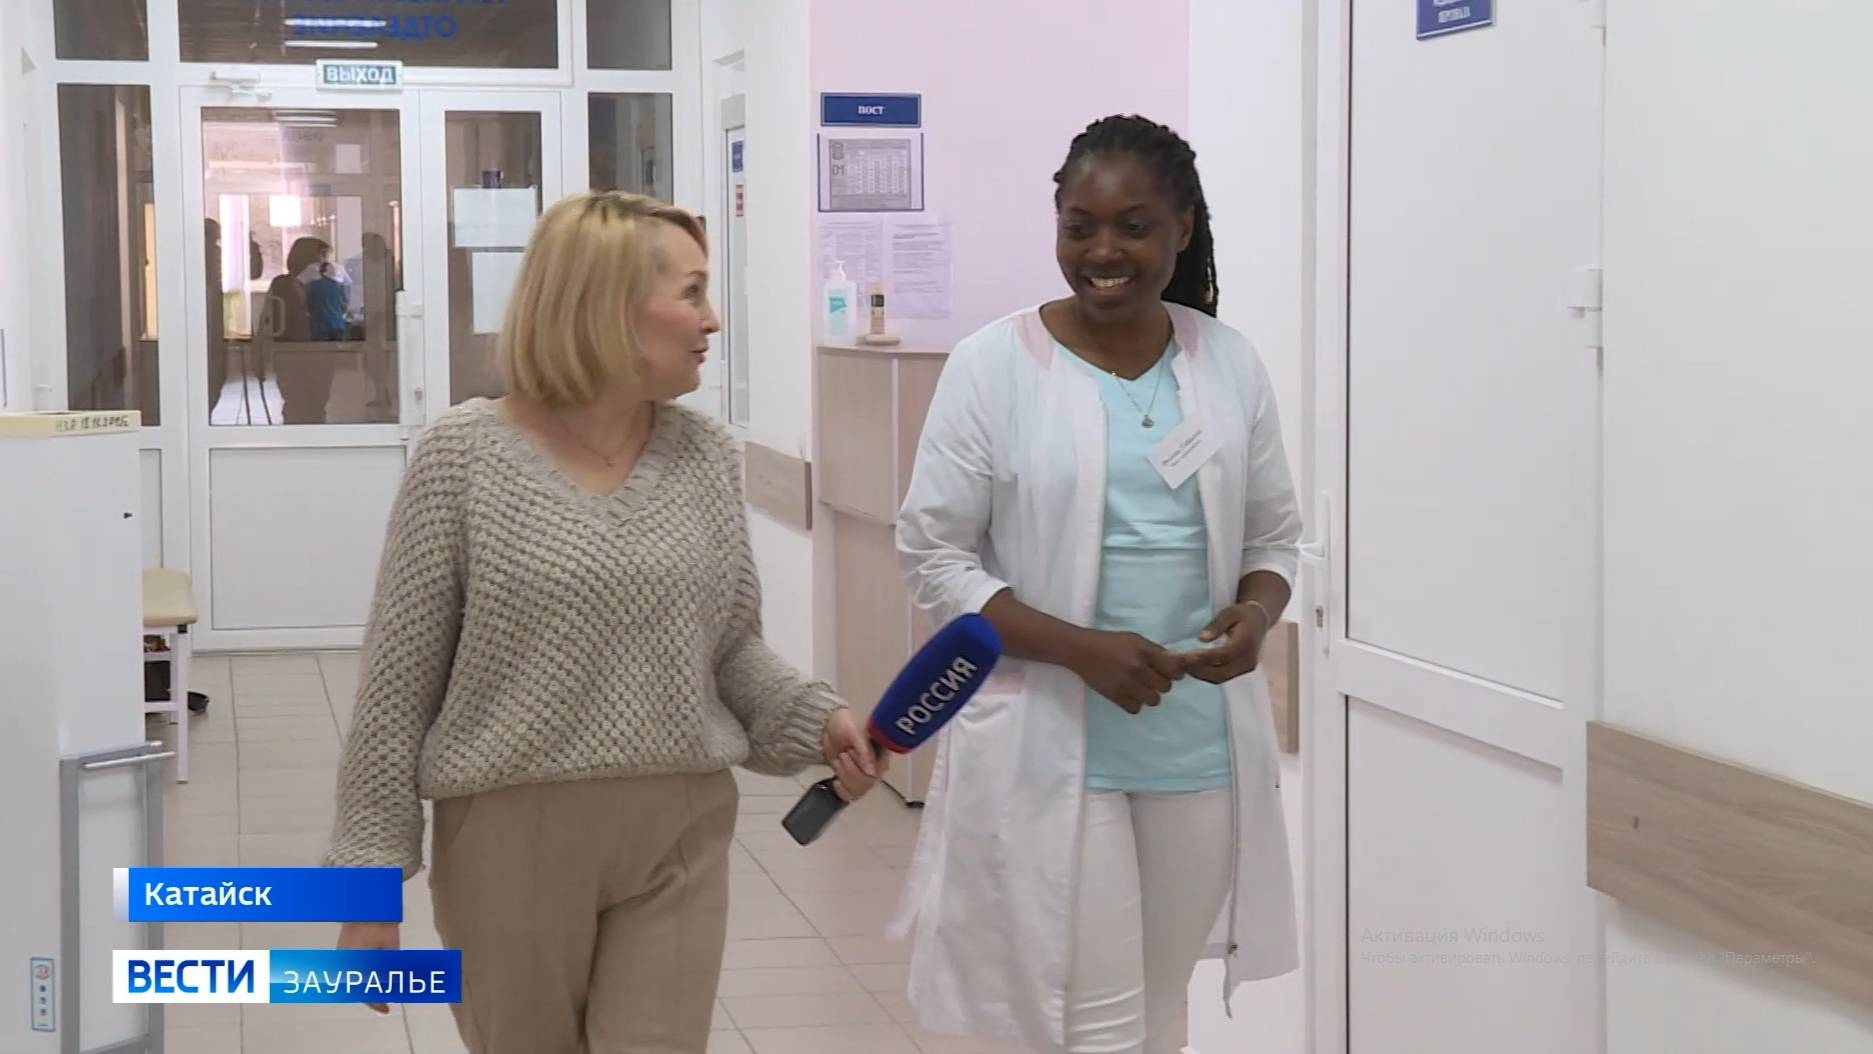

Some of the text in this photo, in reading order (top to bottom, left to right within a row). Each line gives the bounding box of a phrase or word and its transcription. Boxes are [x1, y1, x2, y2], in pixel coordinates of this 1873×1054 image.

[326, 66, 394, 84] ВЫХОД
[857, 105, 885, 115] ПОСТ
[896, 656, 977, 735] РОССИЯ
